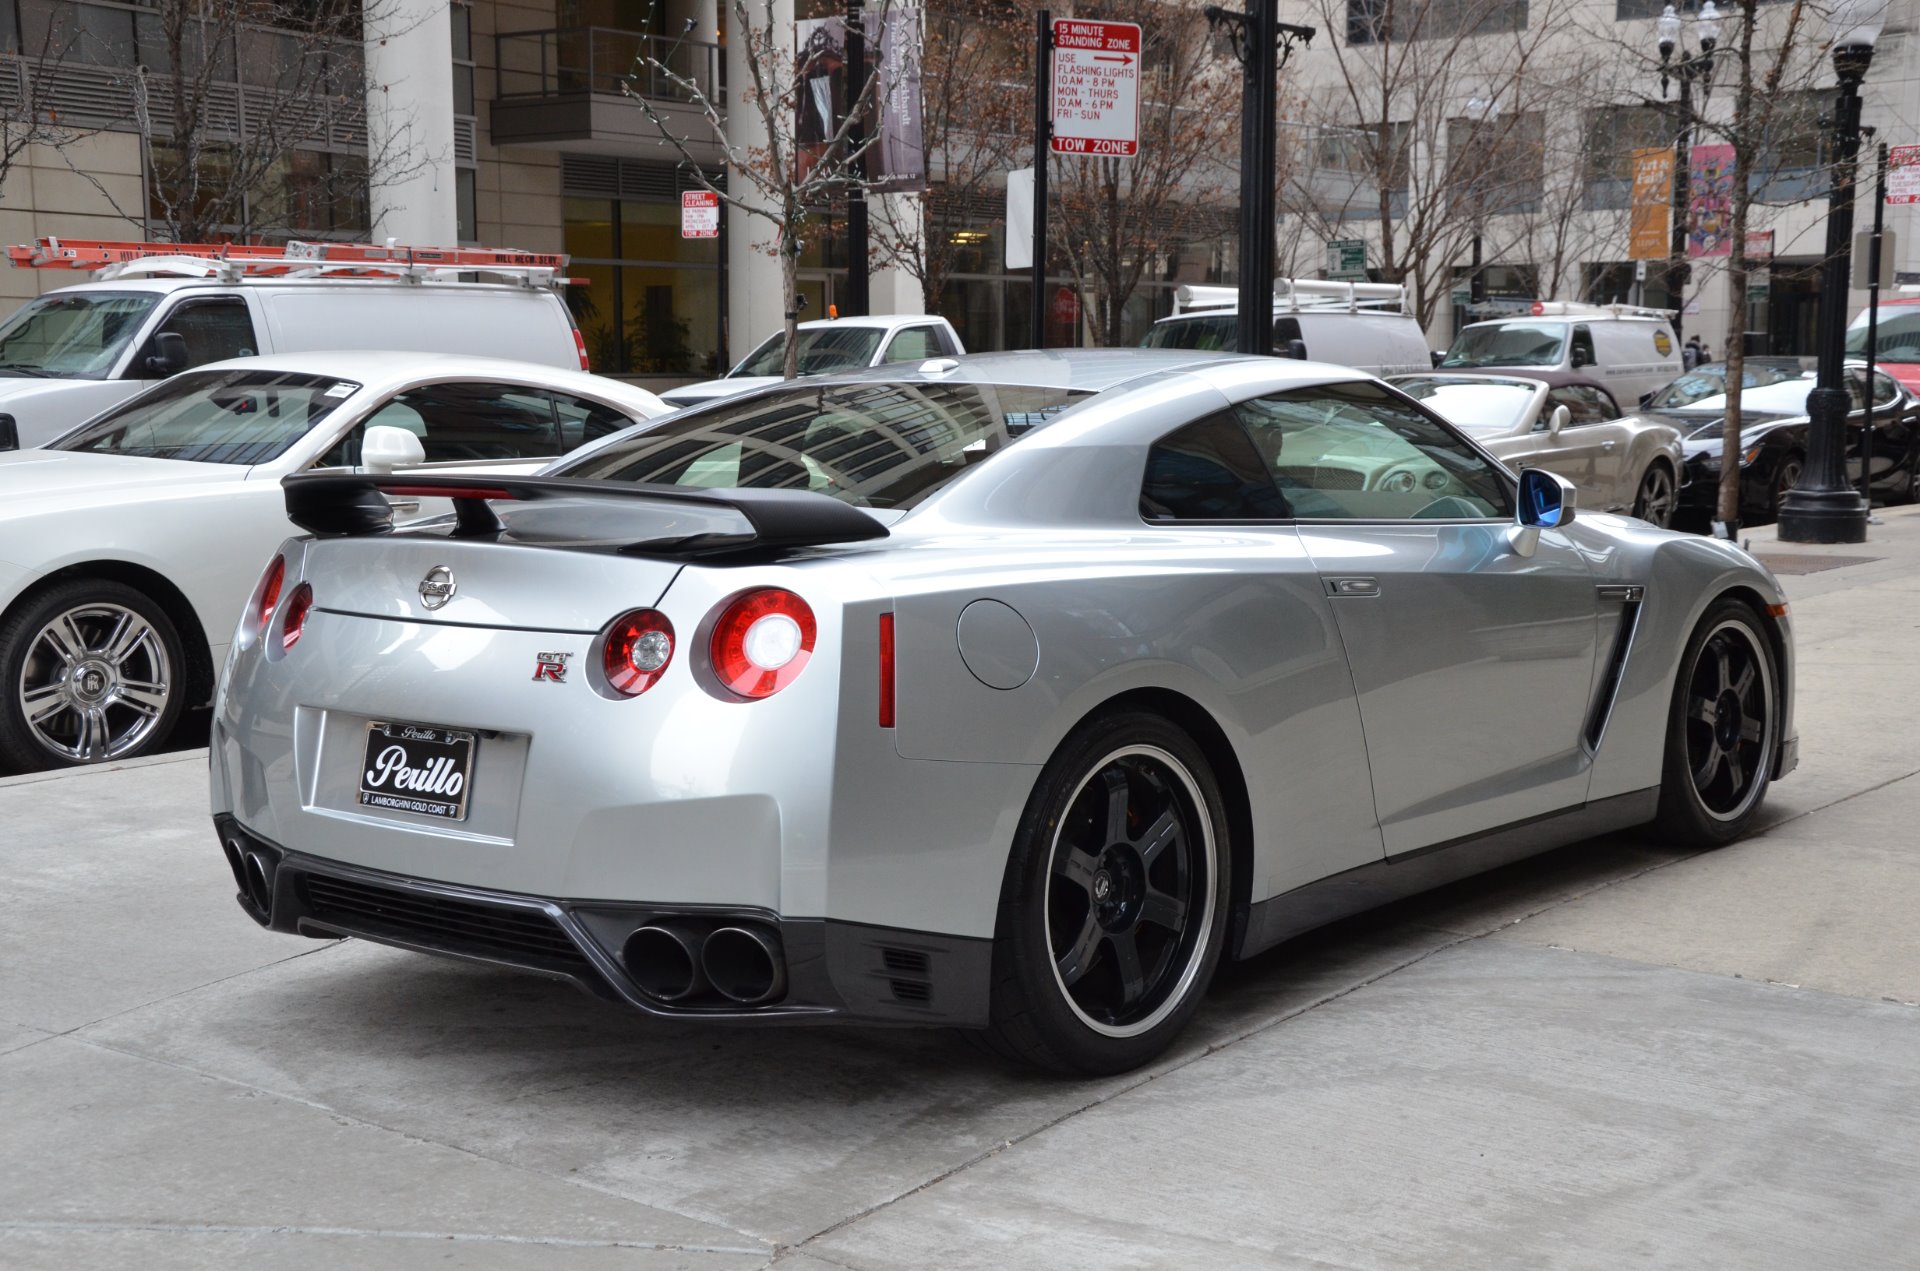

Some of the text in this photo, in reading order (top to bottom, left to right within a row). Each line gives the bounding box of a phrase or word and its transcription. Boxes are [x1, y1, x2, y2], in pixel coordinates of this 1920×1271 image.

[1059, 23, 1104, 37] 15 MINUTE
[1059, 35, 1130, 50] STANDING ZONE
[1058, 53, 1076, 63] USE
[1058, 65, 1134, 78] FLASHING LIGHTS
[1058, 75, 1068, 85] 10
[1069, 76, 1083, 86] AM
[1093, 78, 1099, 87] 8
[1102, 79, 1115, 87] PM
[1058, 86, 1078, 96] MON
[1089, 88, 1119, 99] THURS
[1057, 97, 1067, 106] 10
[1068, 98, 1082, 108] AM
[1092, 100, 1098, 109] 6
[1100, 101, 1113, 110] PM
[1057, 109, 1072, 118] FRI
[1081, 110, 1100, 120] SUN
[1057, 138, 1130, 153] TOW ZONE
[685, 193, 706, 201] STREET
[685, 199, 714, 207] CLEANING
[1890, 196, 1909, 204] TOW
[496, 255, 512, 264] HILL
[401, 726, 436, 740] Perillo
[366, 745, 464, 796] Perillo
[370, 796, 447, 815] LAMBORGHINI GOLD COAST
